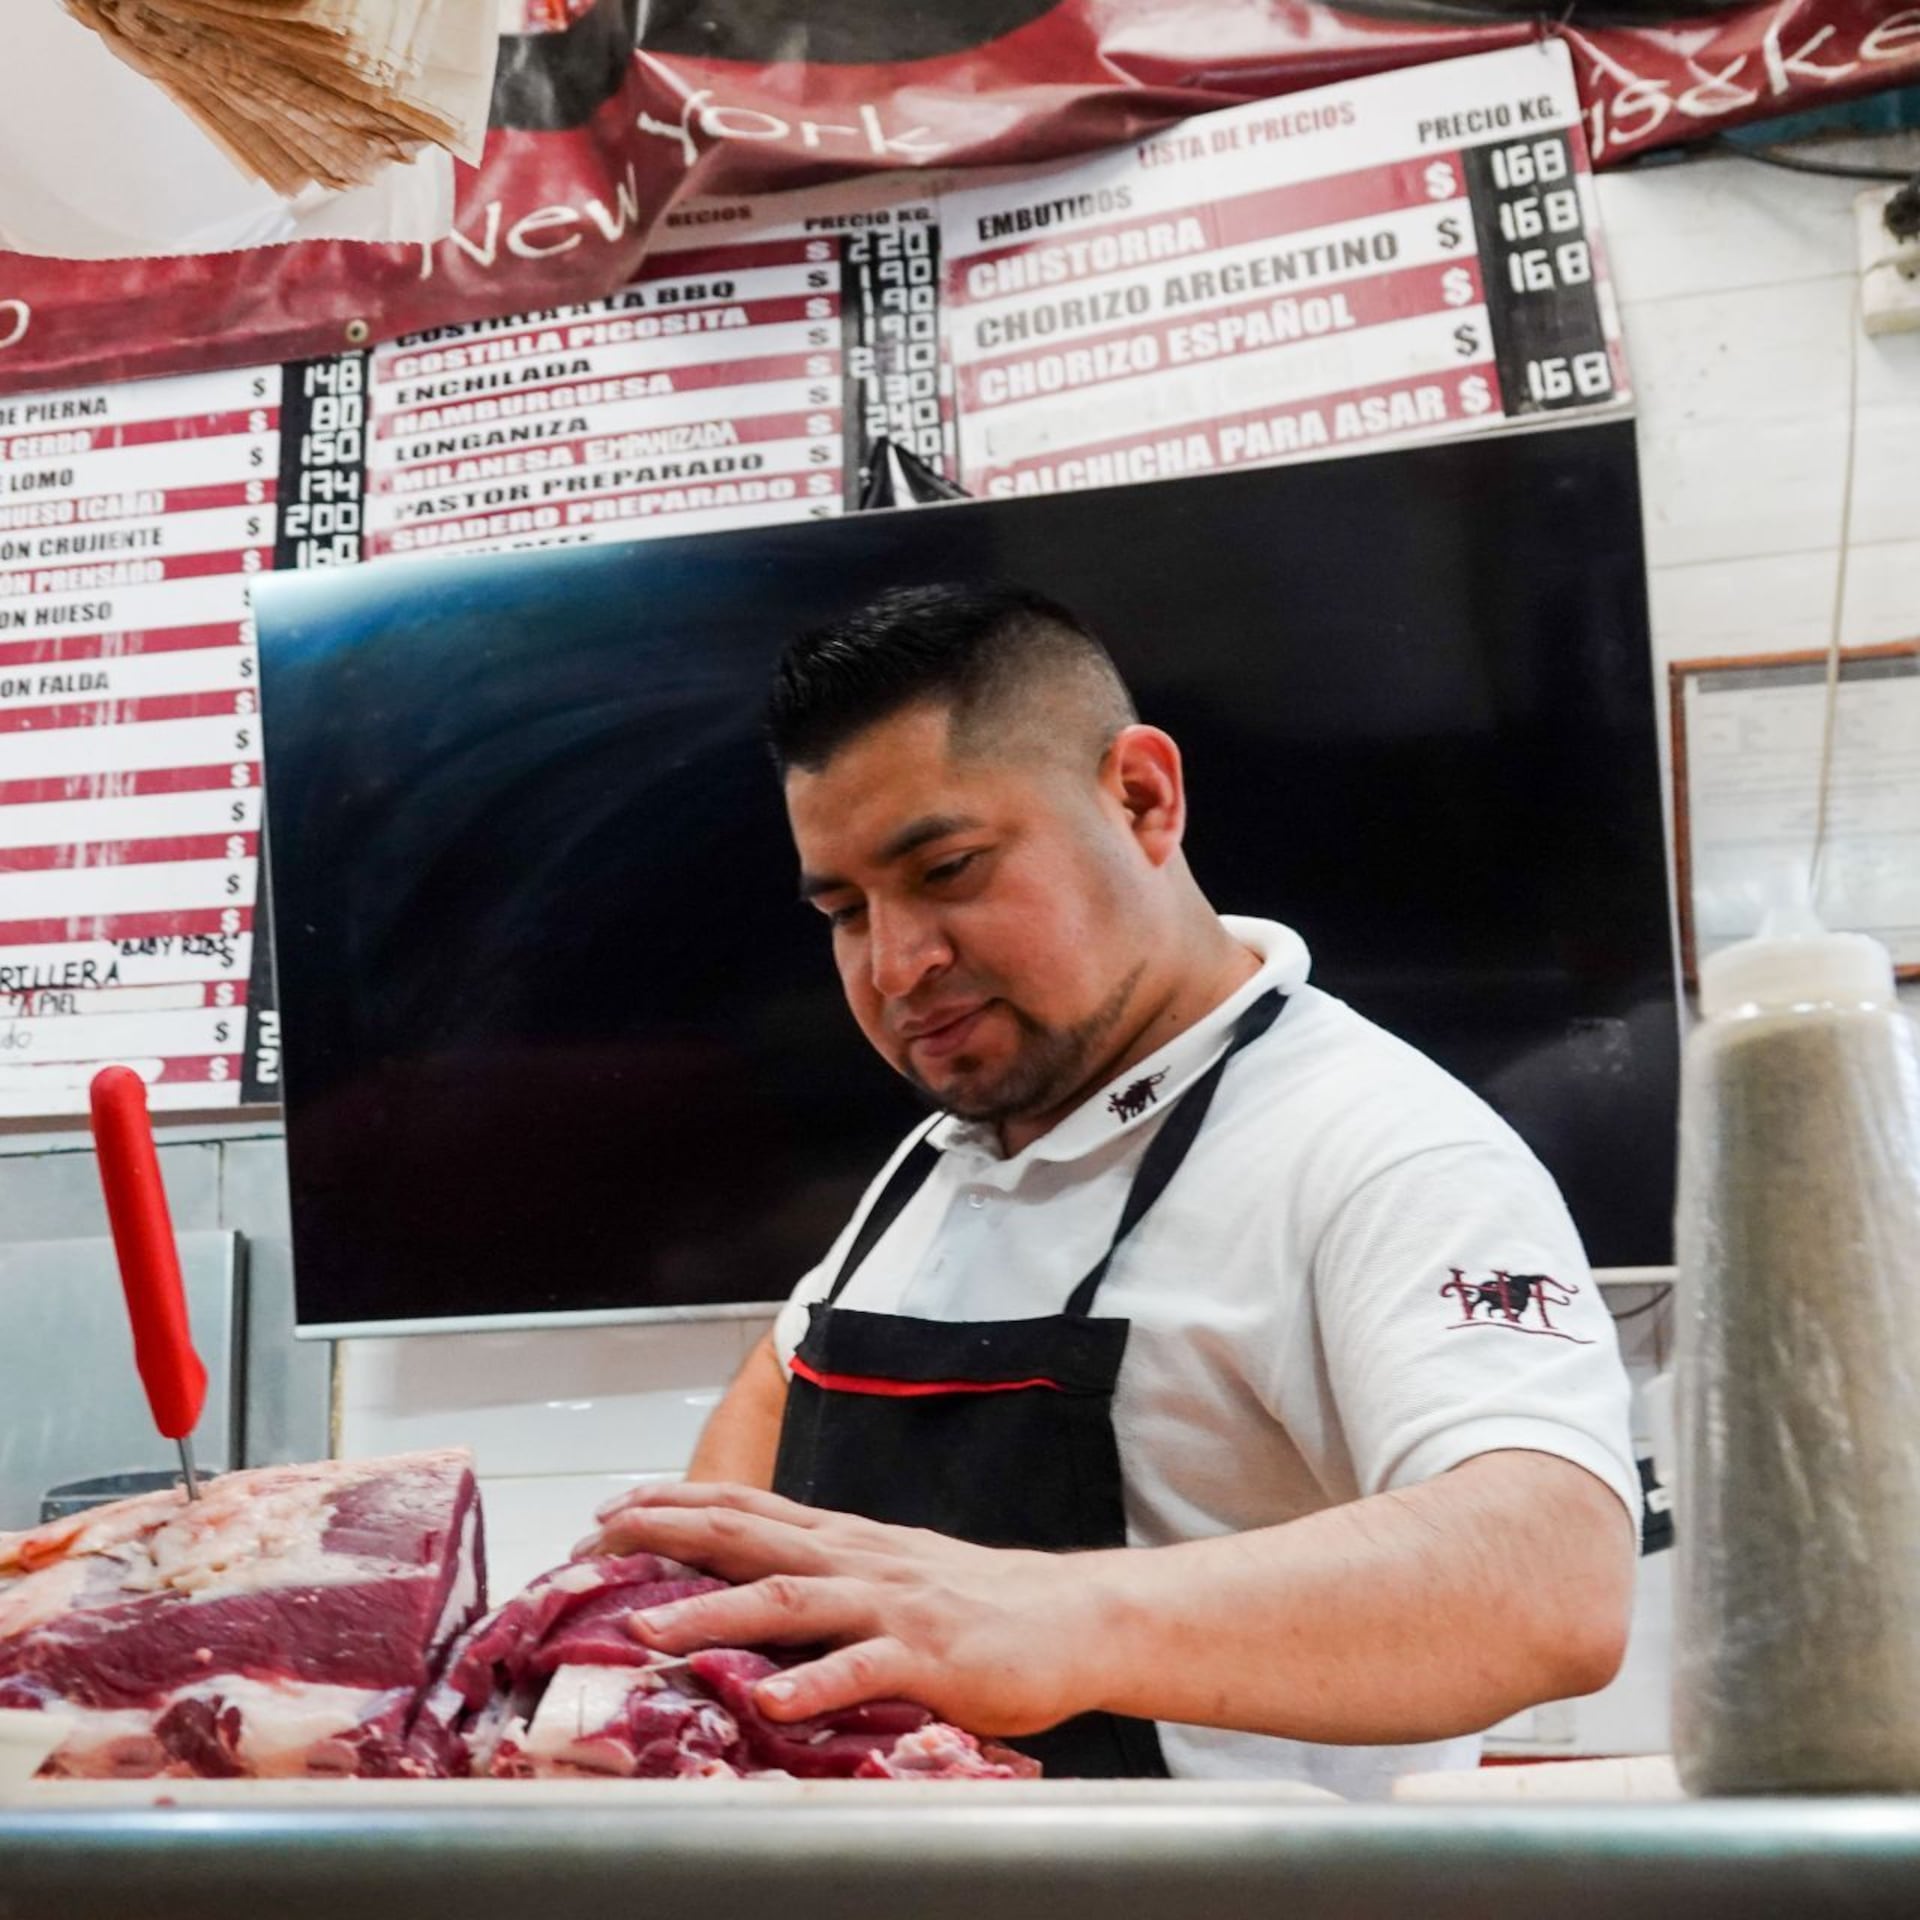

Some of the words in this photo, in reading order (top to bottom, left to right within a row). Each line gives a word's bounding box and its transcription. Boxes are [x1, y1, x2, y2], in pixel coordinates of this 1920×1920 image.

[1138, 133, 1205, 170] LISTA
[1211, 125, 1243, 152] DE
[1248, 101, 1357, 146] PRECIOS
[1418, 103, 1511, 143] PRECIO
[421, 165, 640, 280] New
[637, 90, 948, 166] York
[977, 186, 1133, 241] EMBUTIDOS
[804, 213, 889, 232] PRECIO
[966, 217, 1206, 299] CHISTORRA
[1491, 138, 1567, 190] 168
[657, 281, 736, 304] BBQ
[975, 284, 1150, 348] CHORIZO
[1163, 231, 1399, 308] ARGENTINO
[1500, 189, 1580, 242] 168
[394, 330, 564, 377] COSTILLA
[567, 307, 748, 351] PICOSITA
[978, 333, 1160, 406] CHORIZO
[1167, 290, 1355, 356] ESPAÑOL
[1508, 240, 1592, 293] 168
[26, 396, 107, 424] PIERNA
[304, 359, 363, 398] 148
[394, 373, 674, 435] HAMBURGUESA
[397, 357, 591, 405] ENCHILADA
[311, 394, 363, 433] 80
[397, 416, 588, 462] LONGANIZA
[988, 431, 1214, 498] SALCHICHA
[1218, 408, 1328, 467] PARA
[1335, 386, 1448, 440] ASAR
[1526, 351, 1613, 402] 168
[10, 467, 74, 493] LOMO
[301, 429, 361, 467] 150
[394, 445, 575, 493] MILANESA
[396, 484, 531, 521] PASTOR
[543, 453, 764, 497] PREPARADO
[38, 526, 163, 558] CRUJIENTE
[284, 501, 360, 537] 200
[390, 506, 560, 552] SUADERO
[566, 477, 797, 527] PREPARADO
[35, 601, 112, 627] HUESO
[38, 671, 109, 695] FALDA
